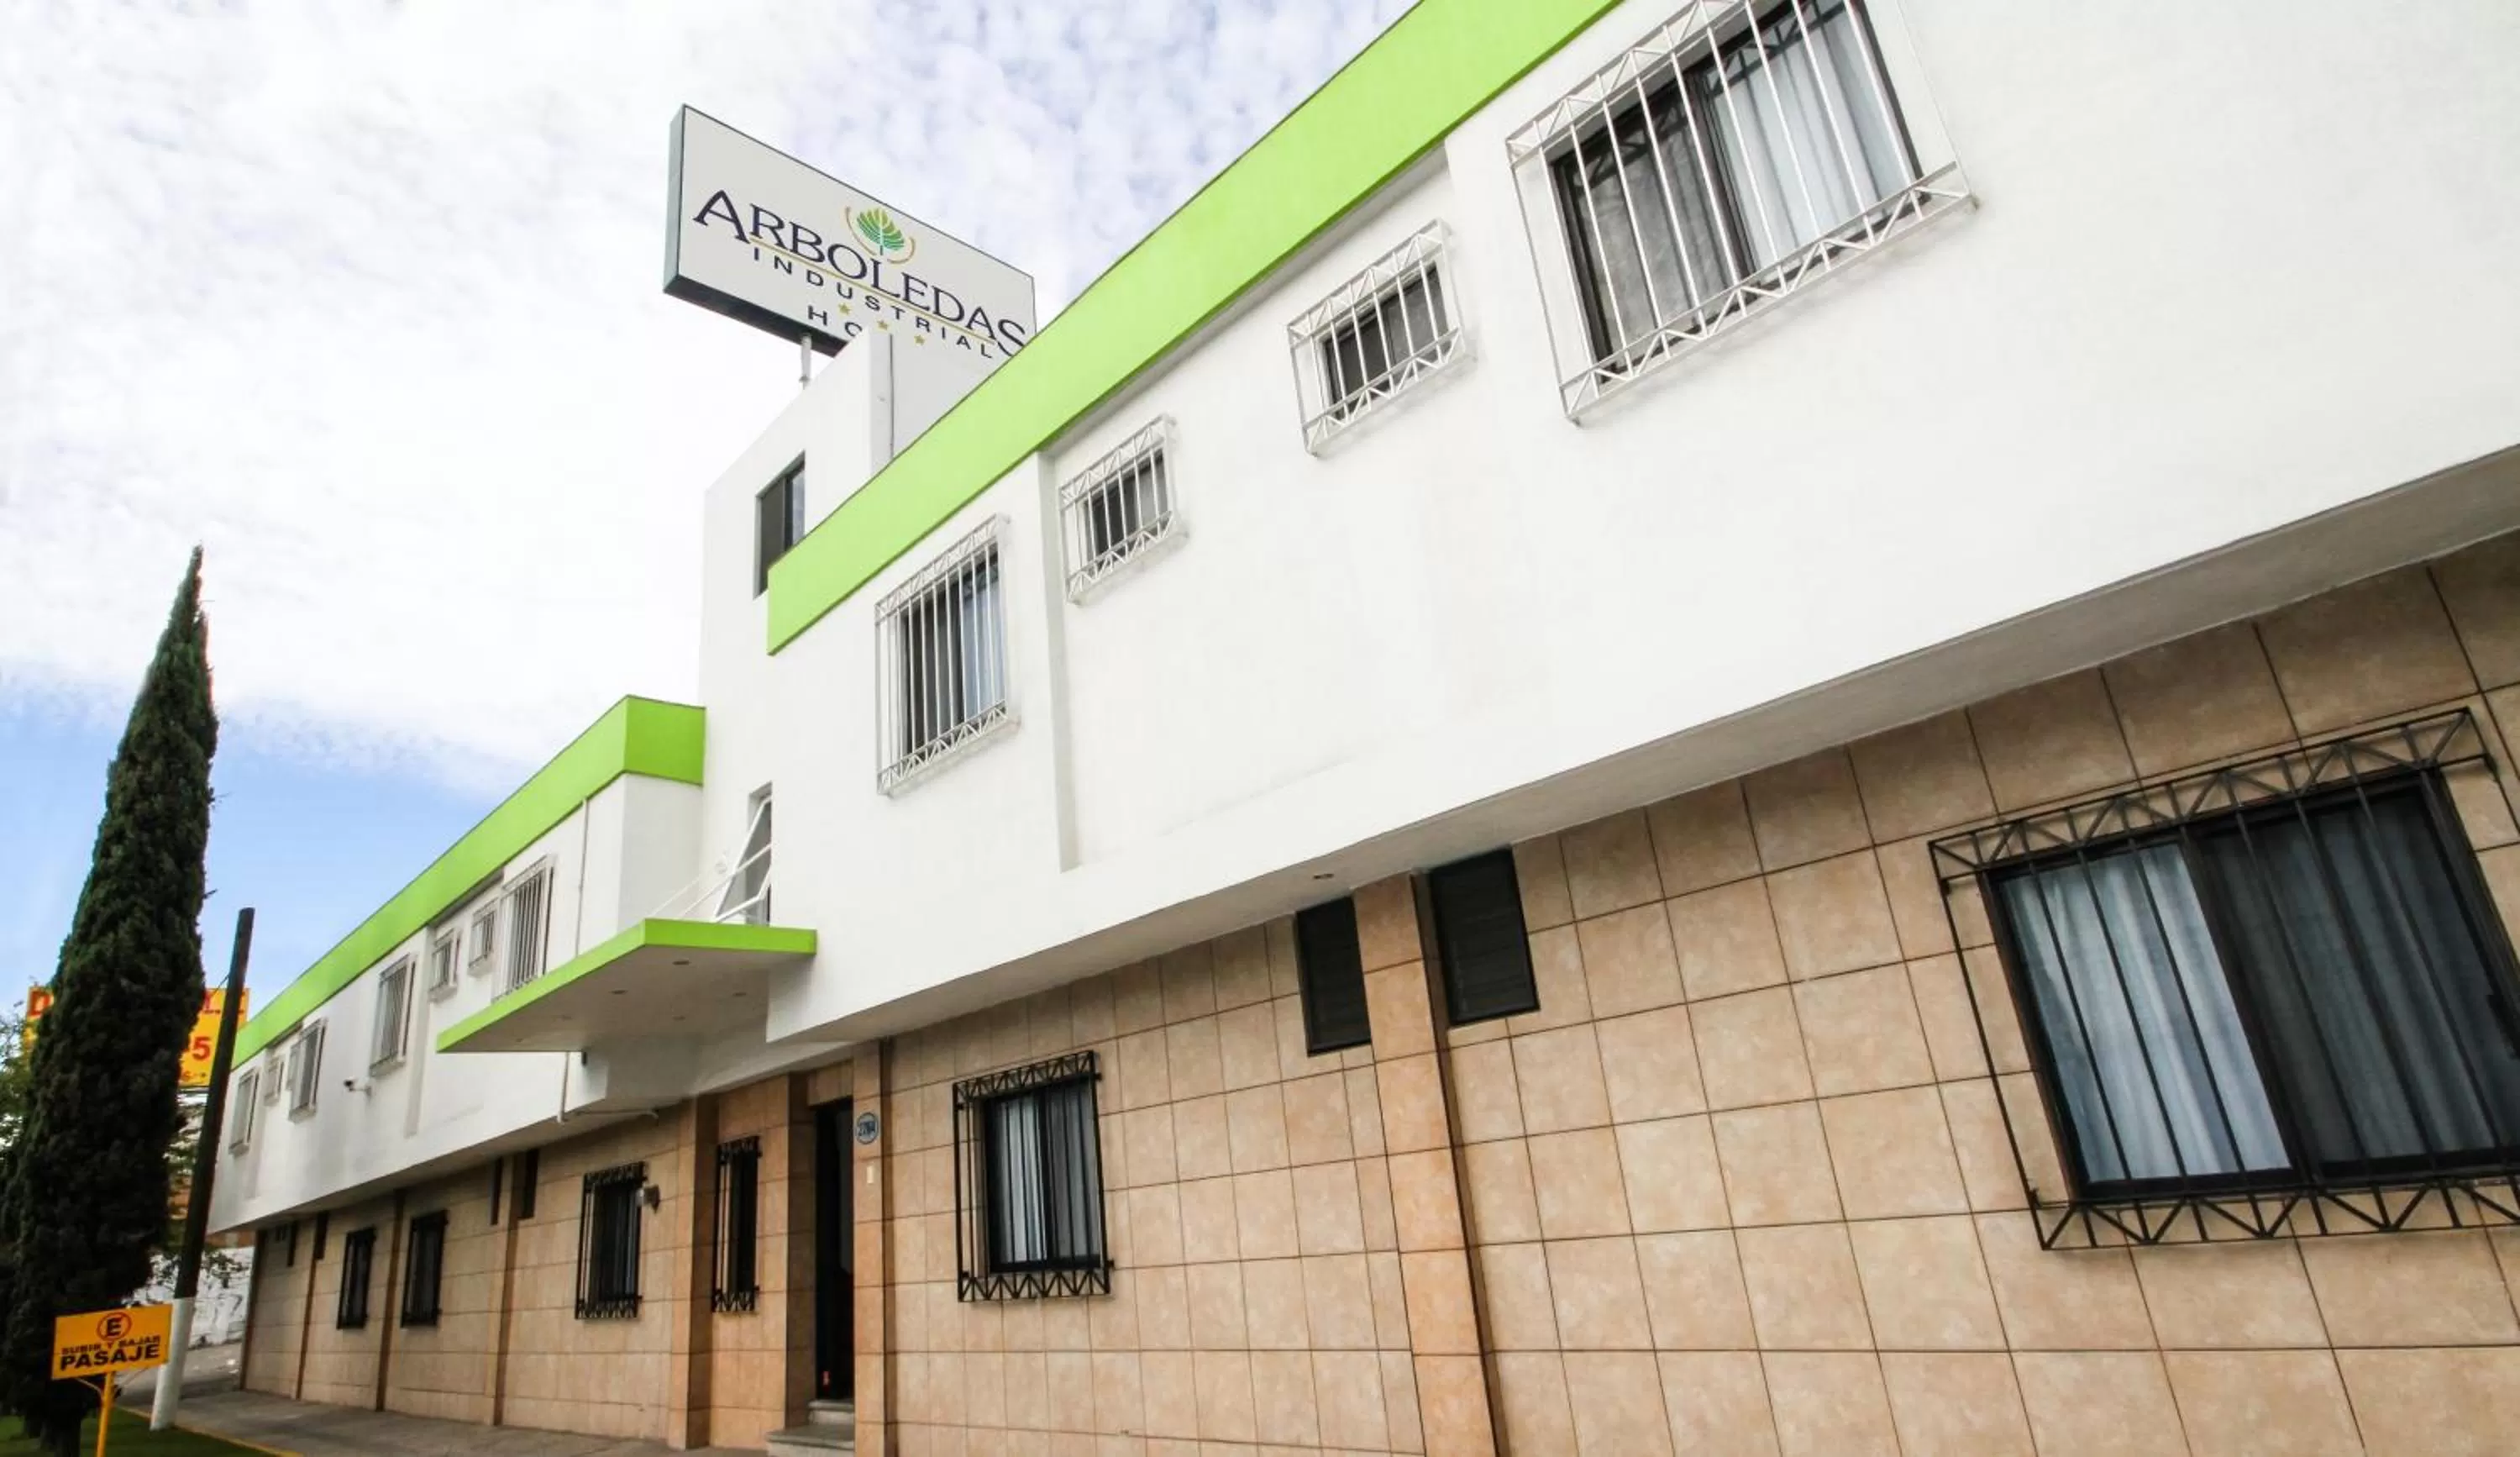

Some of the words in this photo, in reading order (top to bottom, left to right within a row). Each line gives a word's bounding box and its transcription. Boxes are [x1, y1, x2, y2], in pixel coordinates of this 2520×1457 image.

[693, 189, 1026, 358] ARBOLEDAS
[754, 246, 994, 360] INDUSTRIAL
[106, 1317, 123, 1337] E
[118, 1334, 160, 1348] BAJAR
[60, 1344, 160, 1371] PASAJE
